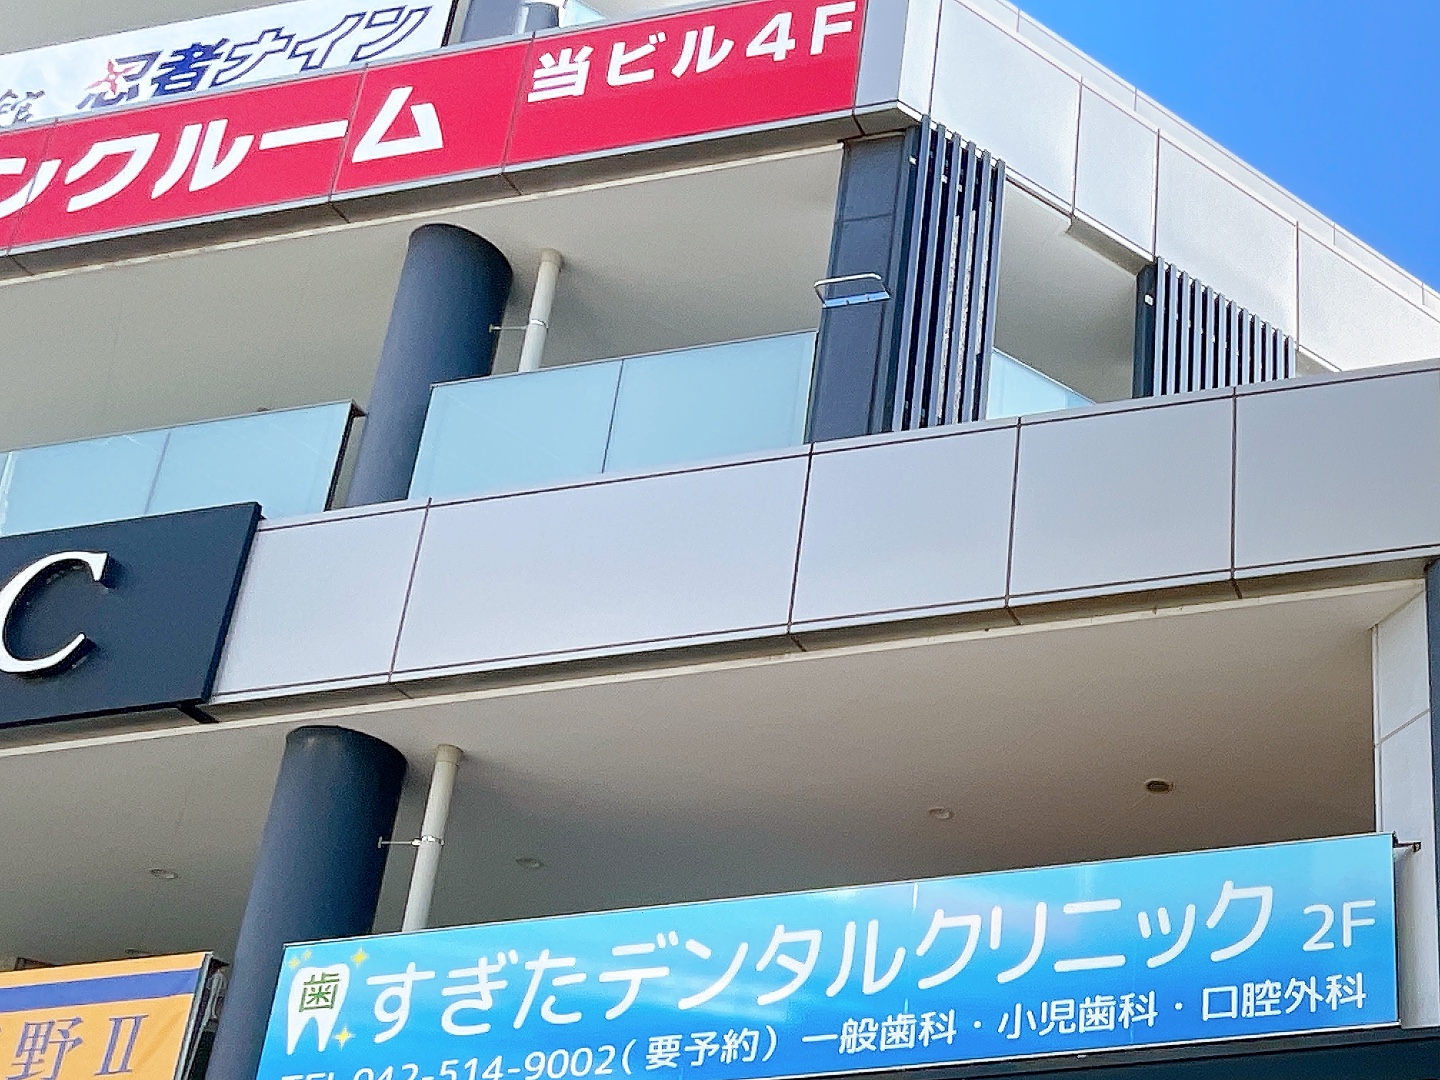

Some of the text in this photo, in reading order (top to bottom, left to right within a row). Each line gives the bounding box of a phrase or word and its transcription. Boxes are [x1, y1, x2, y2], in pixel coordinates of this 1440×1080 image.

[528, 3, 856, 102] 当ビル4F
[299, 973, 340, 1012] 歯
[366, 881, 1377, 1043] すぎたデンタルクリニック 2F
